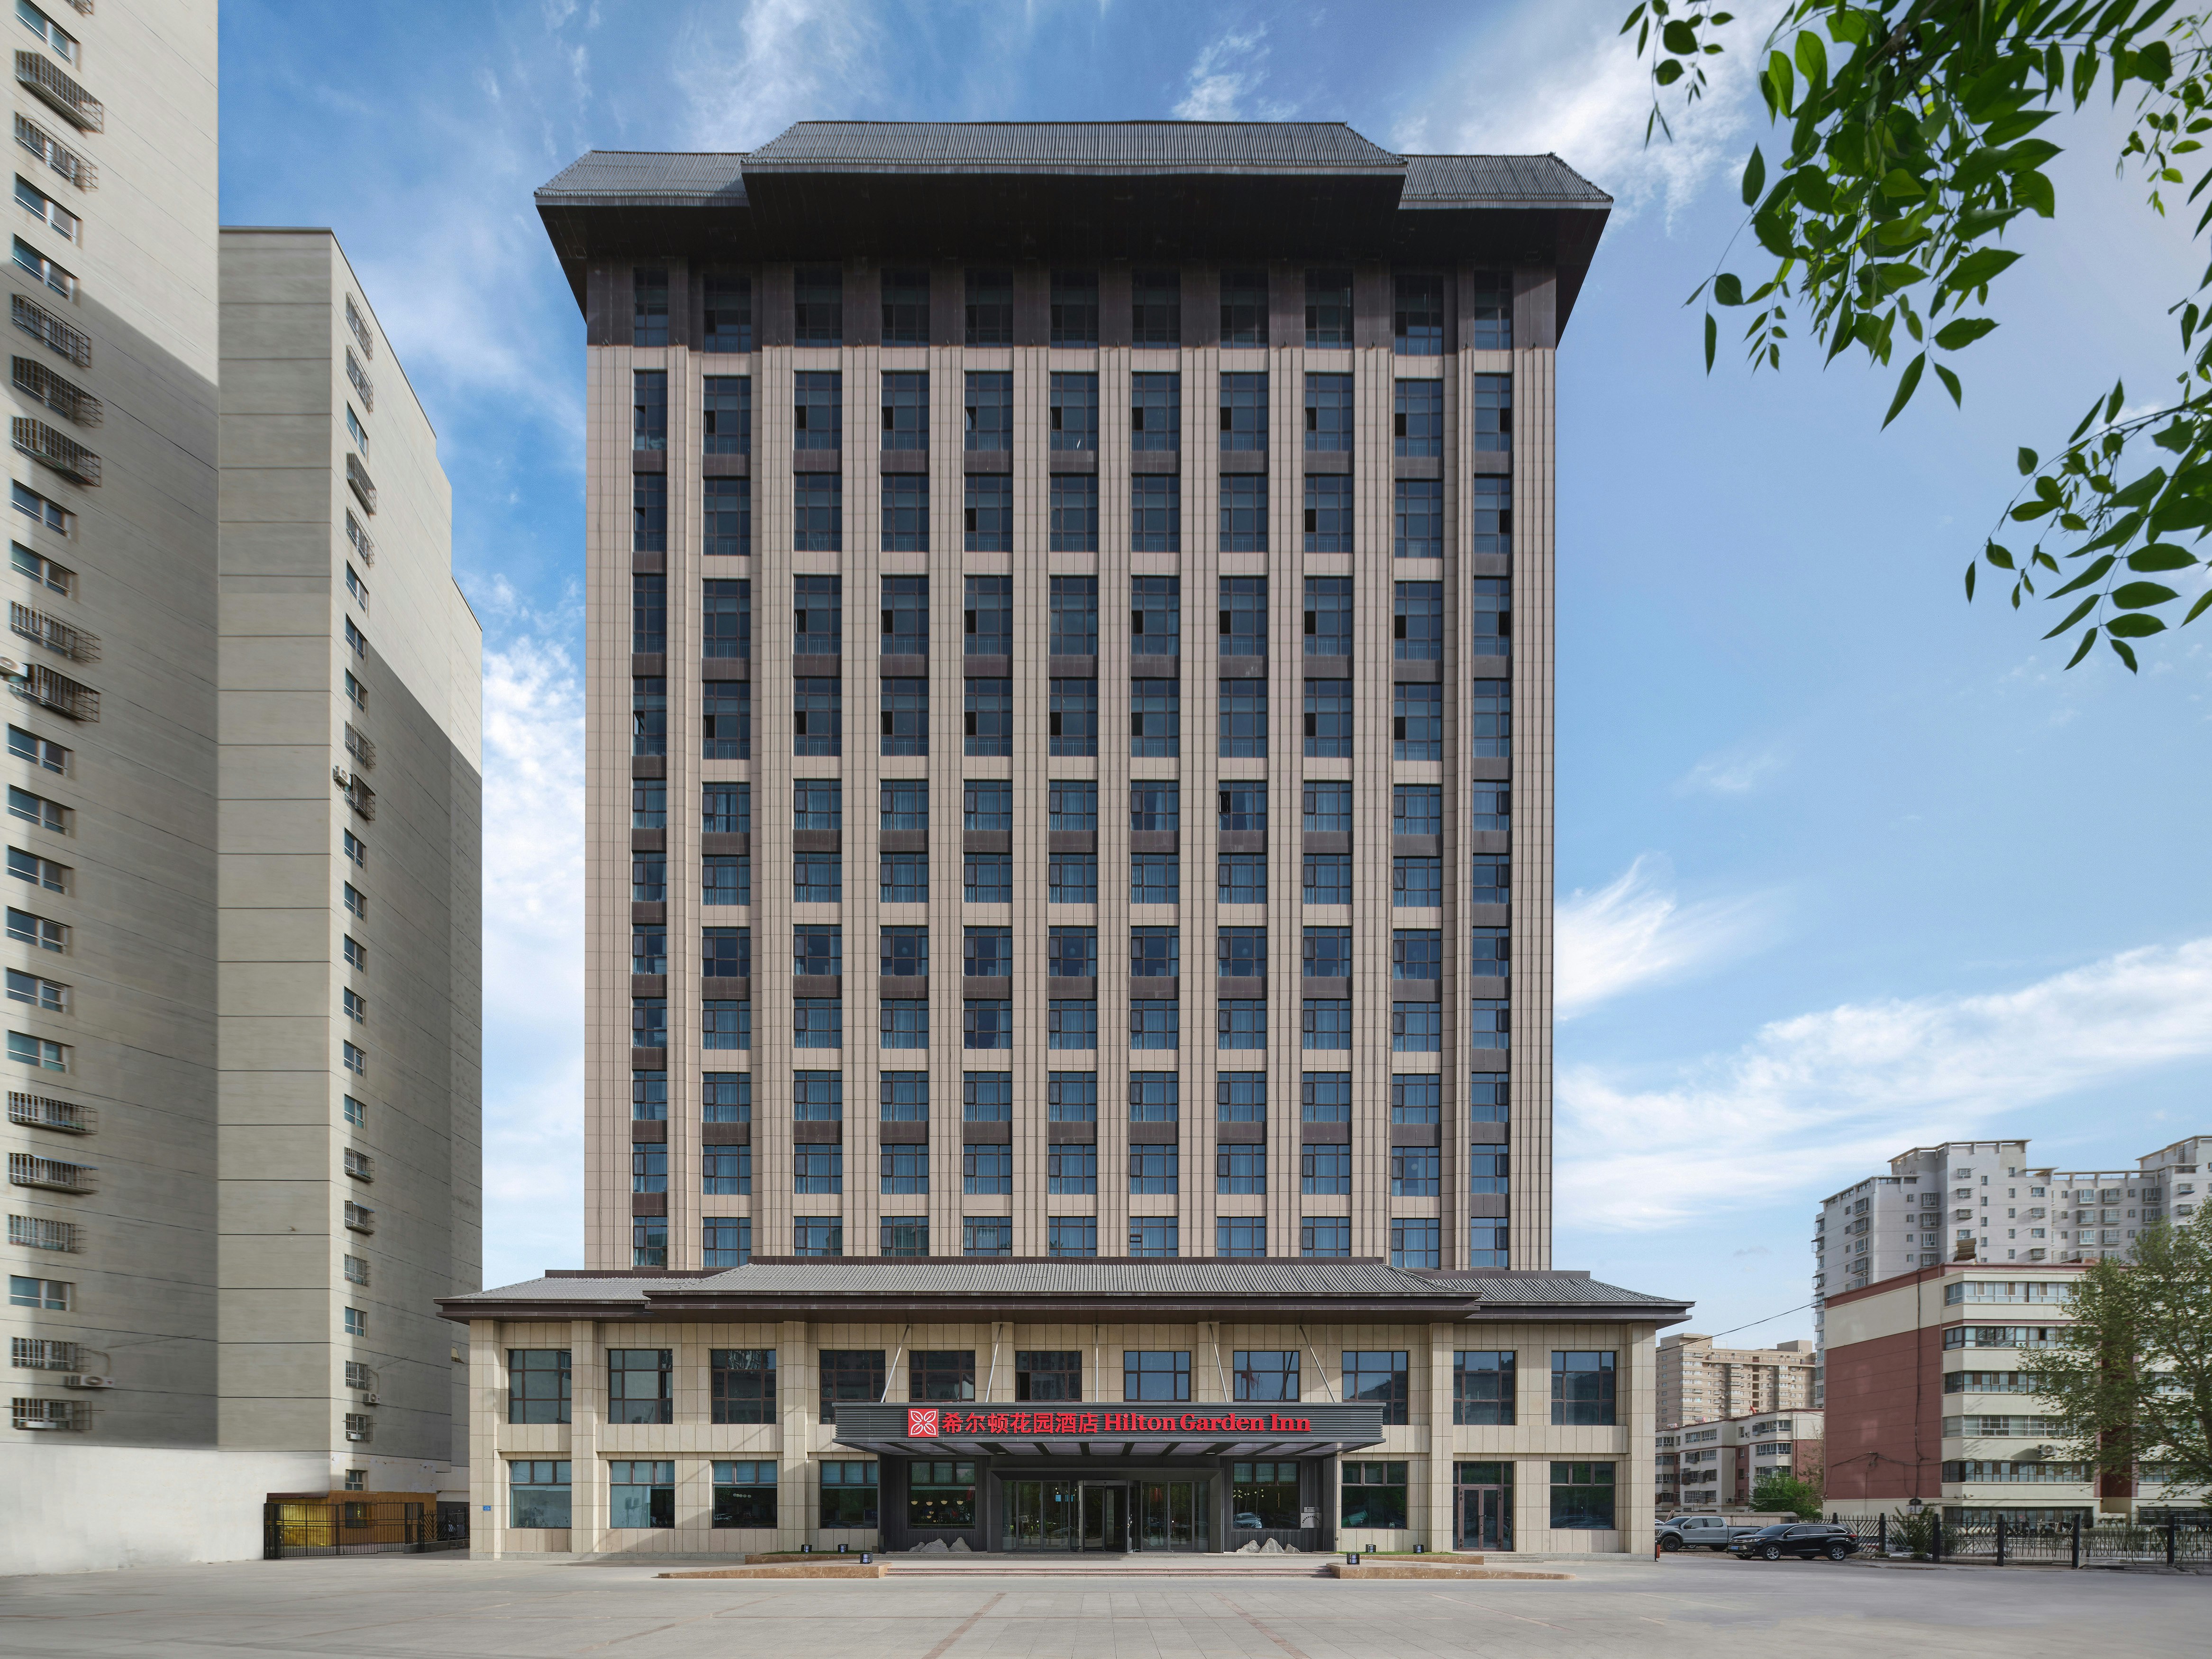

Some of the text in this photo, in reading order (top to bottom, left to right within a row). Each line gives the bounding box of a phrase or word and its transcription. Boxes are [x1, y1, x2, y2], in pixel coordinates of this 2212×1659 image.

[942, 1412, 1099, 1434] 希尔顿花园酒店
[1104, 1413, 1311, 1431] Hilton Garden Inn
